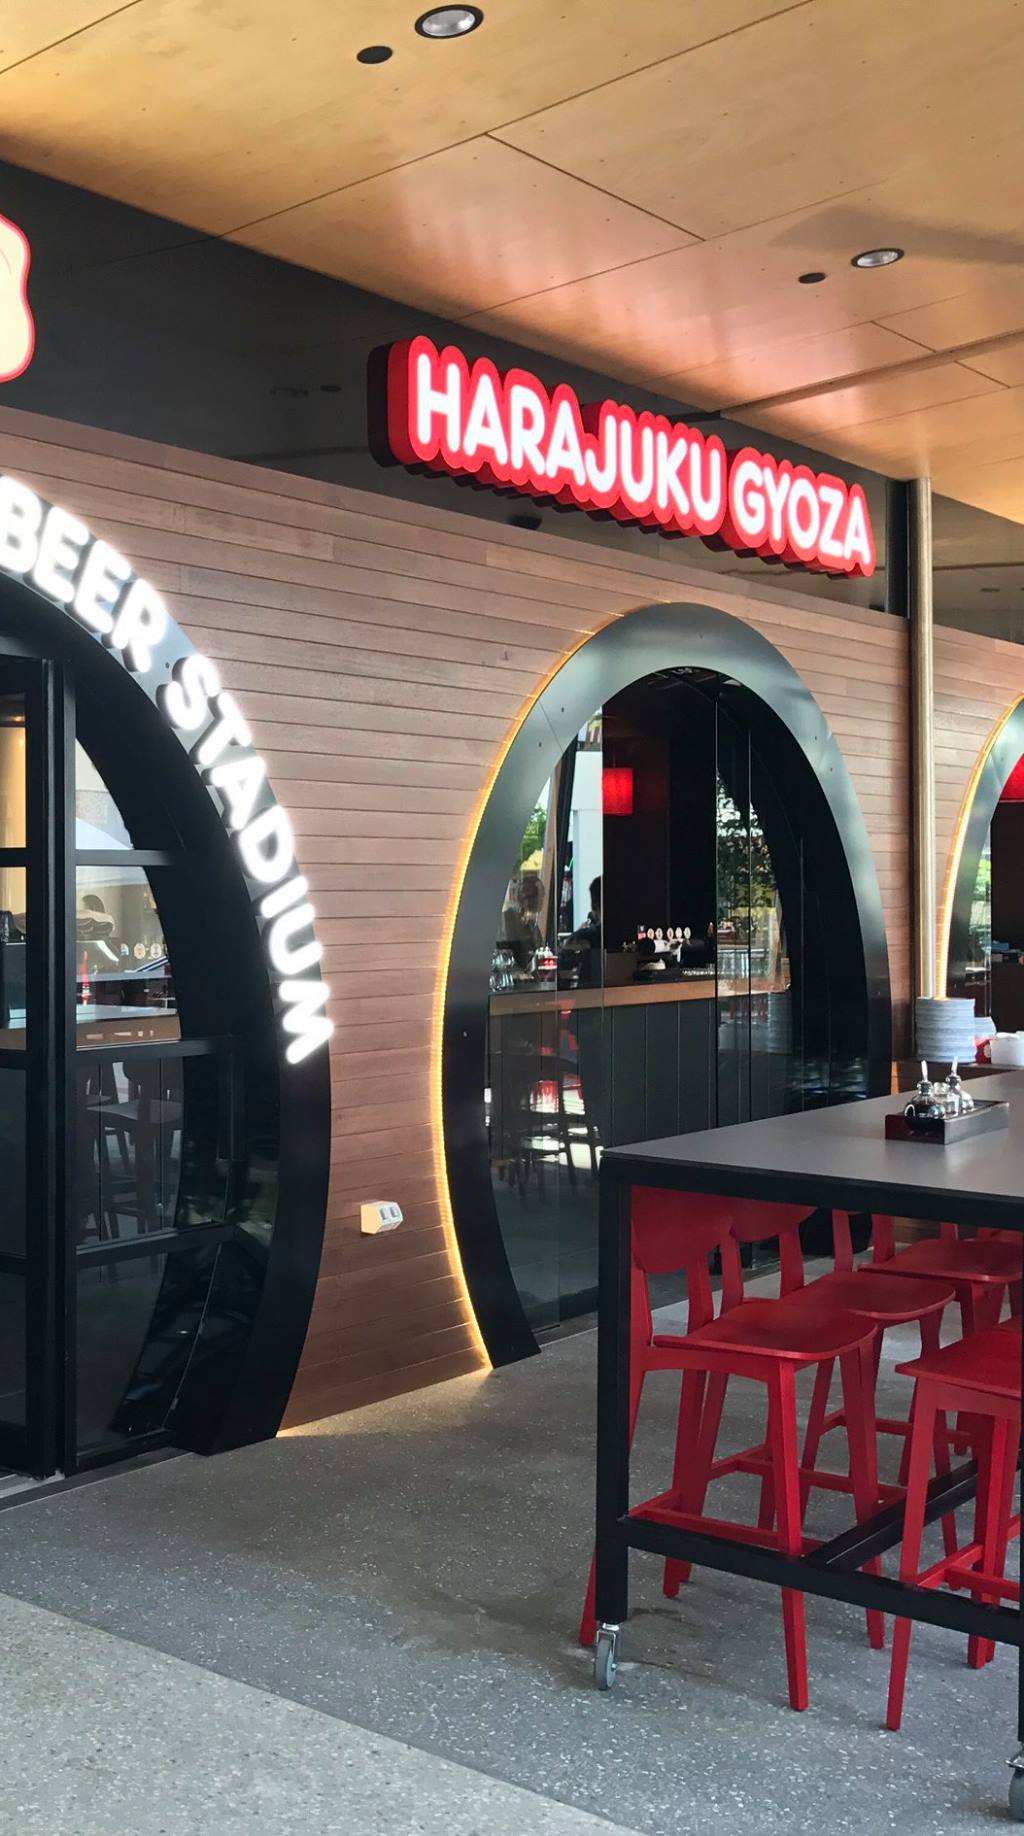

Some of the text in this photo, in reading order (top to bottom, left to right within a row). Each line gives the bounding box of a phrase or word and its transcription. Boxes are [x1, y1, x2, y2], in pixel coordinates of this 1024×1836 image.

[416, 352, 872, 566] HARAJUKU GYOZA
[165, 651, 335, 1065] STADIUM
